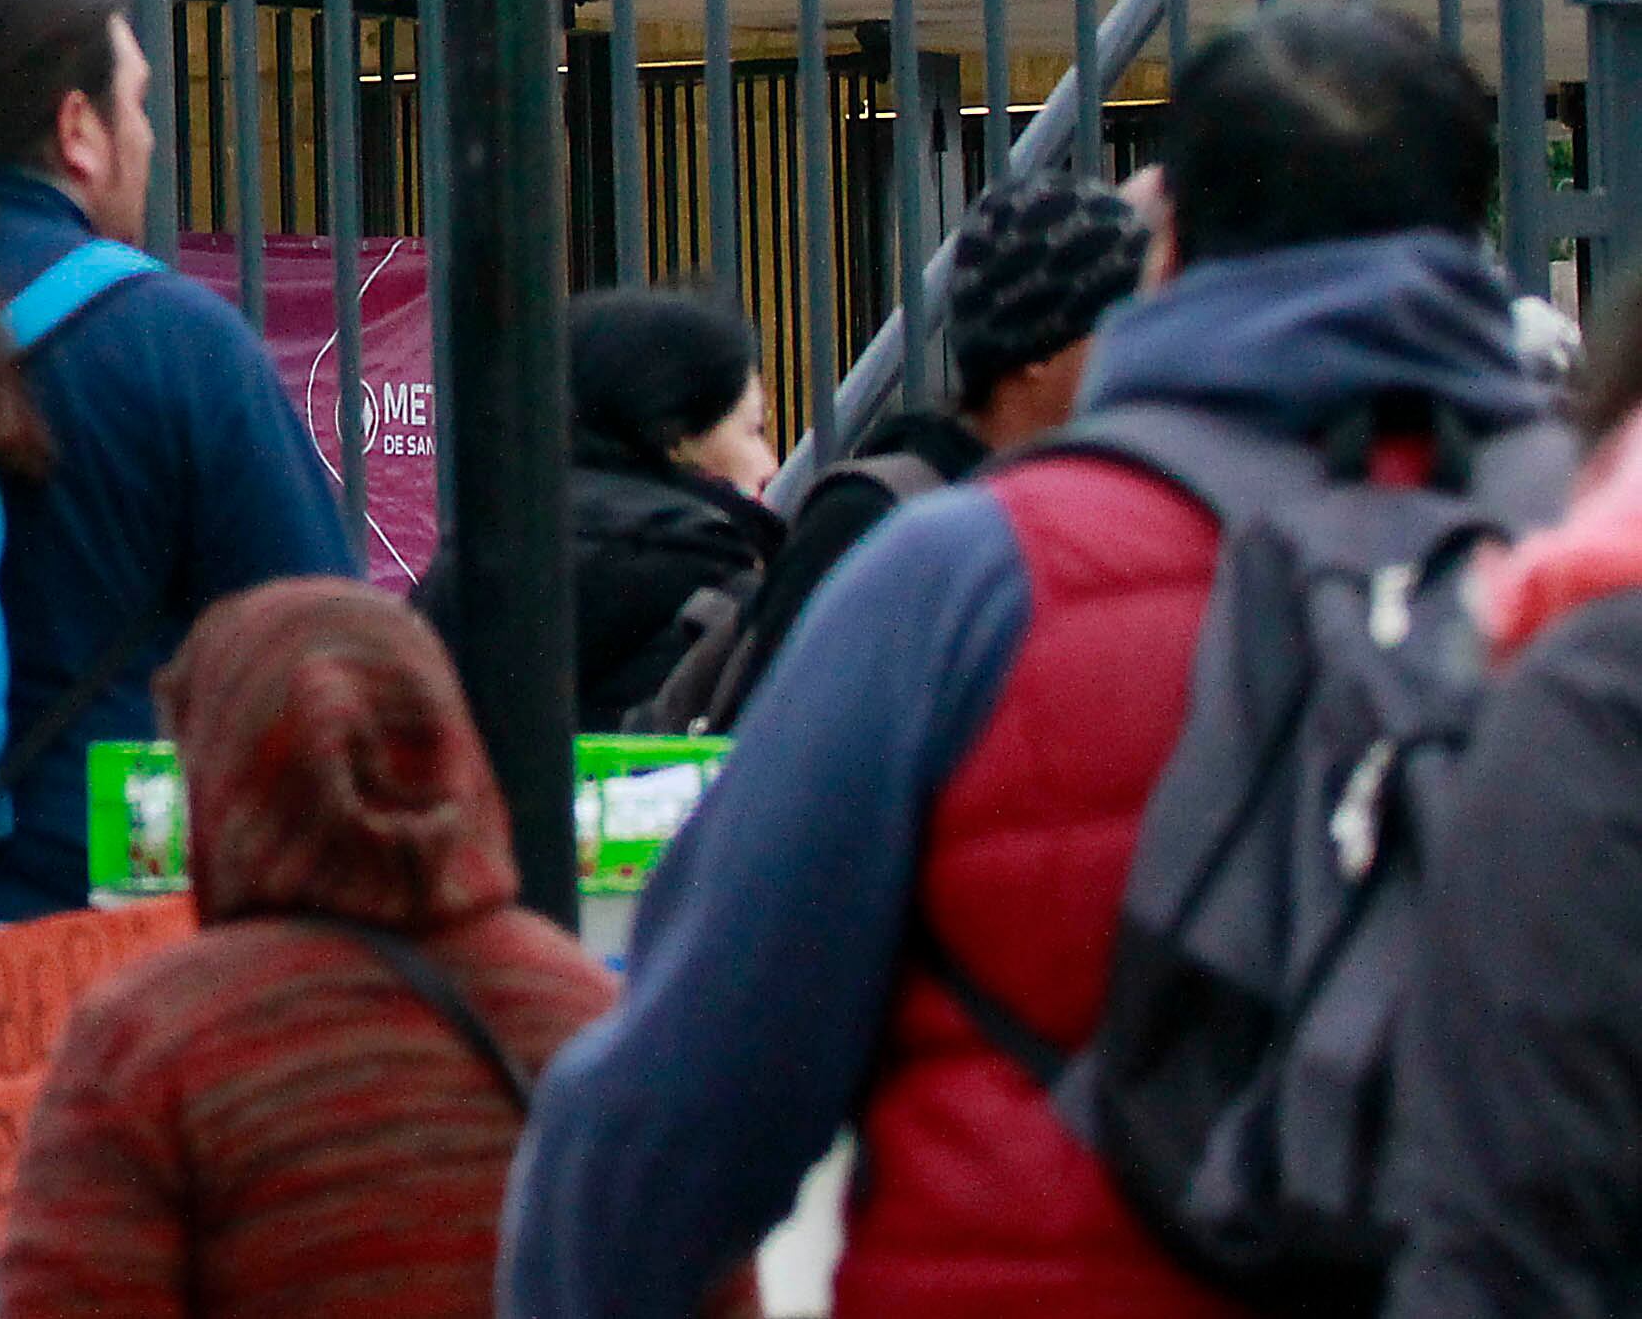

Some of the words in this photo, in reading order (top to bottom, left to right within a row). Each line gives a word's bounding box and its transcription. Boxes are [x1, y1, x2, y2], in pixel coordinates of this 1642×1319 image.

[383, 381, 436, 426] MET
[383, 434, 404, 456] DE
[406, 434, 436, 456] SAN
